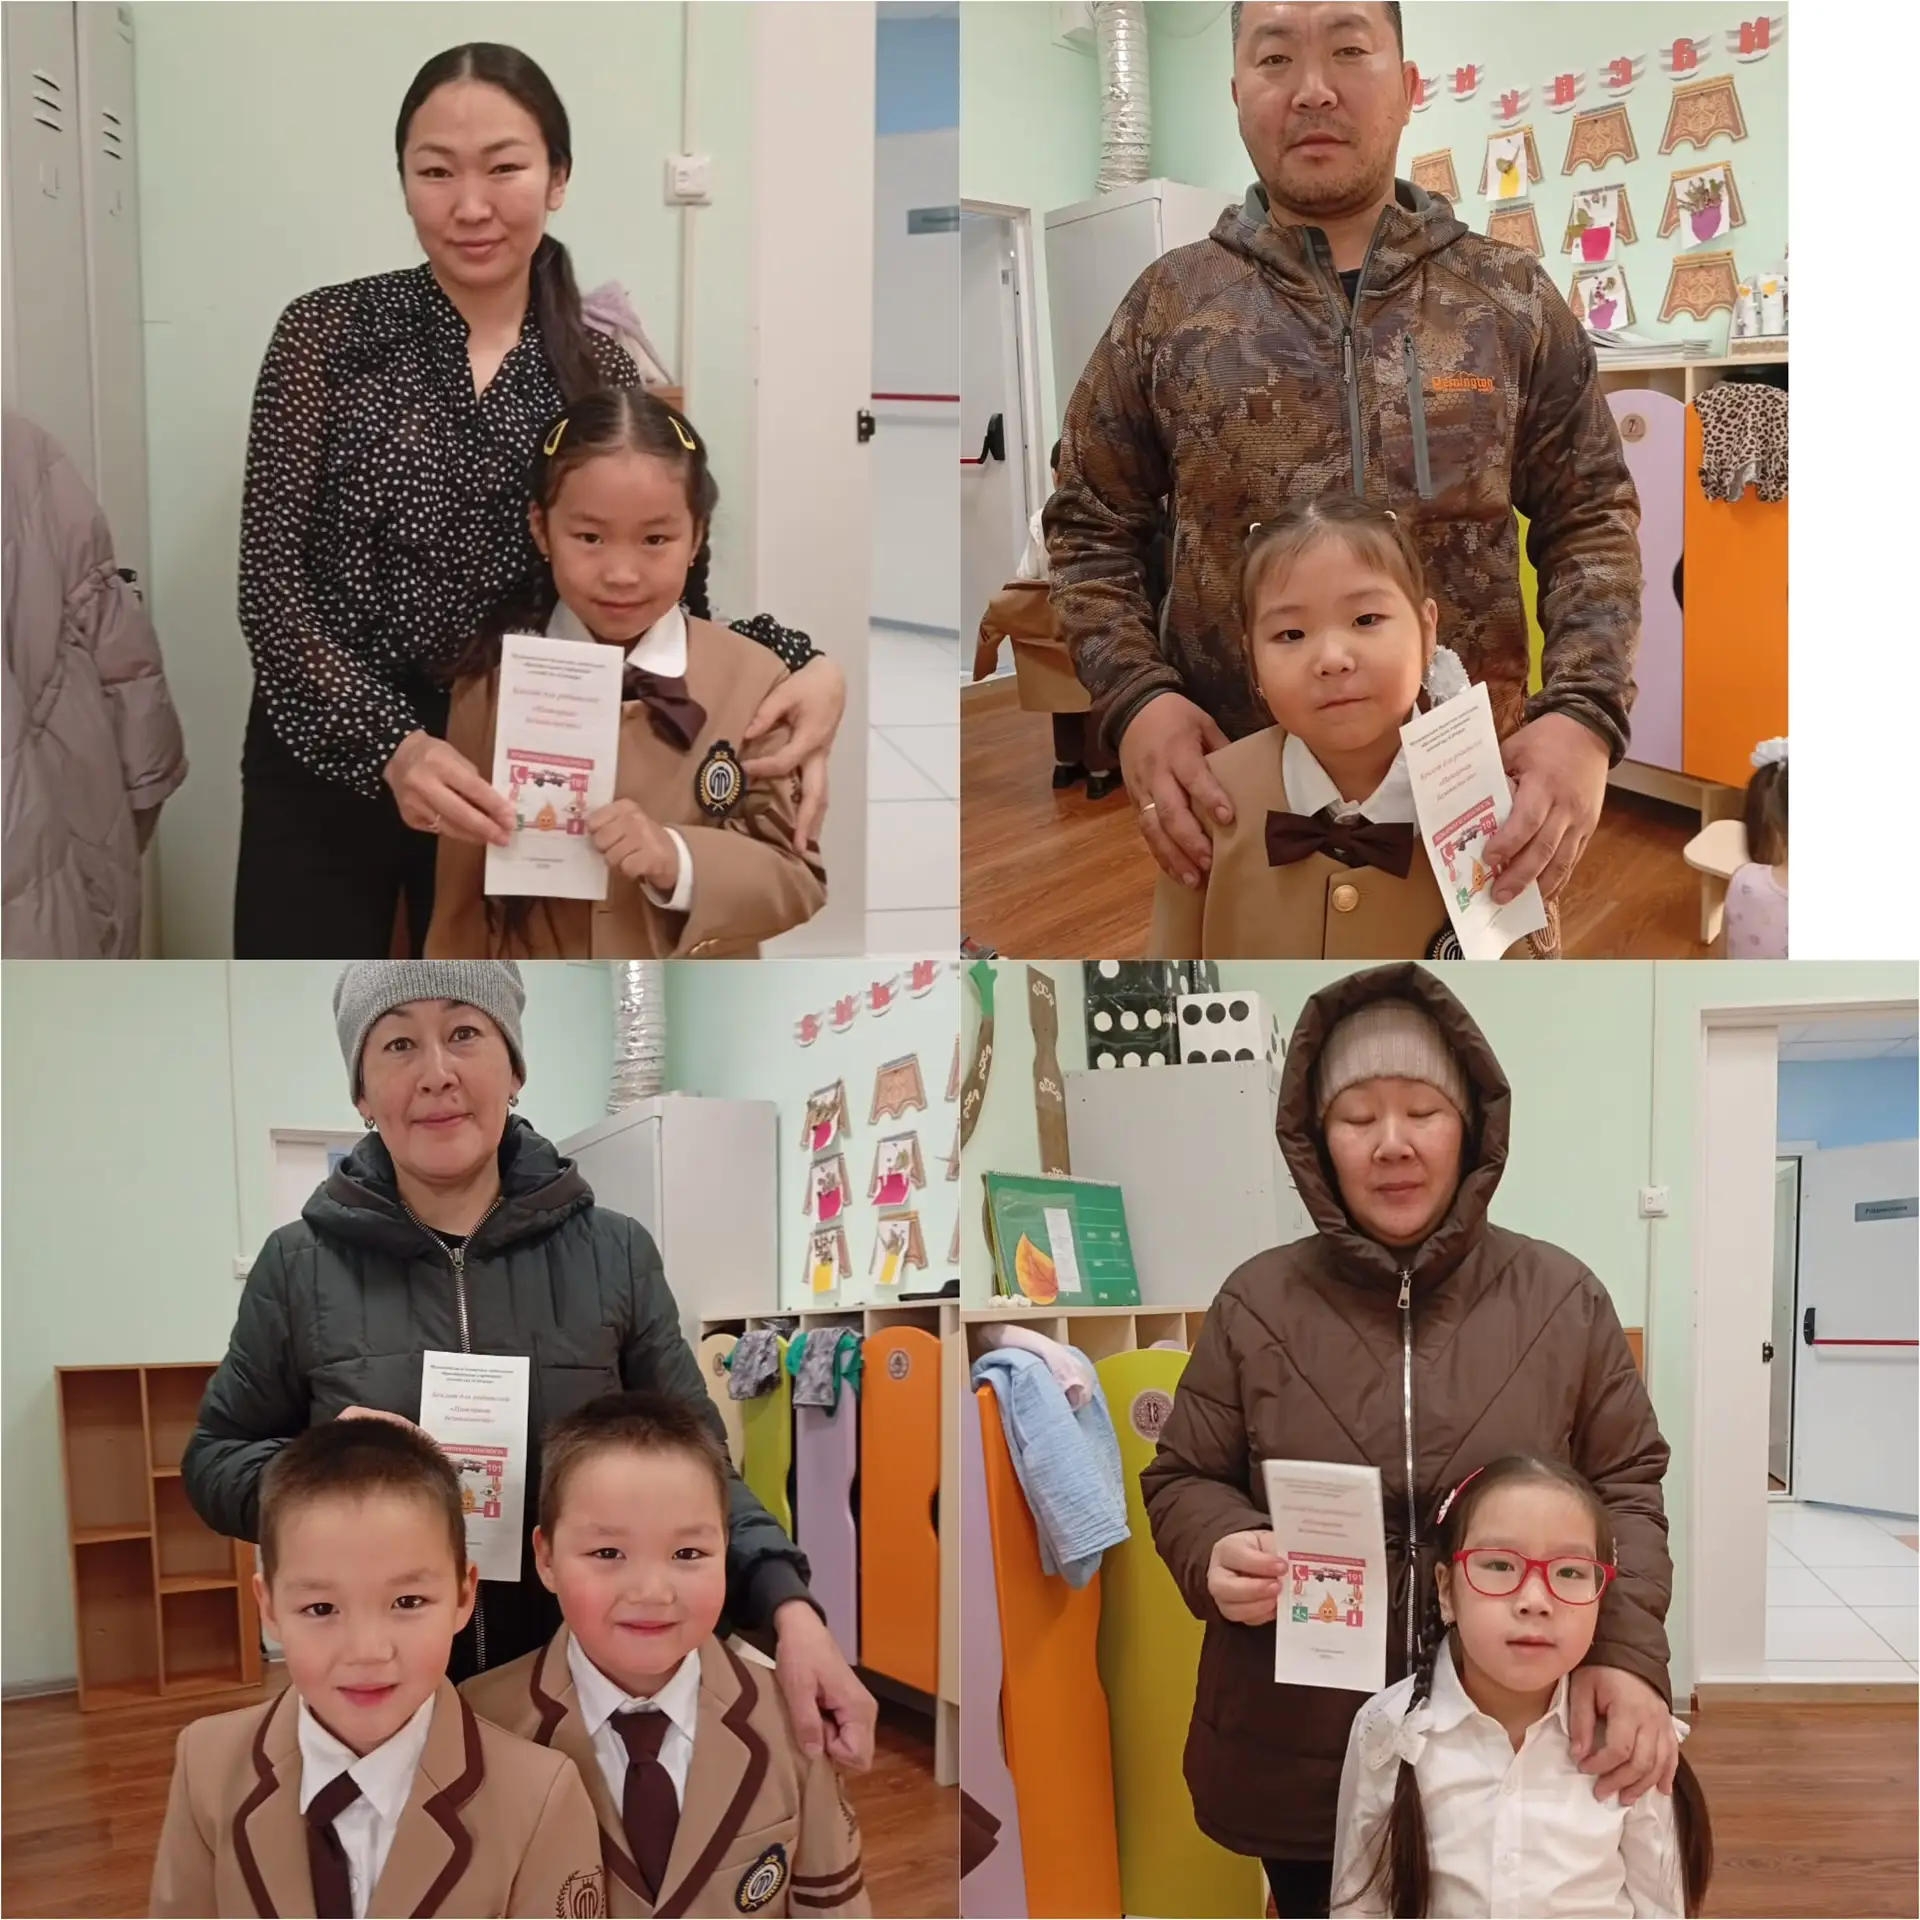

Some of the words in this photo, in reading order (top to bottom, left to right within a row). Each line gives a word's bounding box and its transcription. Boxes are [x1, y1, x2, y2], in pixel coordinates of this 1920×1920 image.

[1481, 815, 1496, 831] 101
[1147, 1401, 1160, 1424] 18
[487, 1463, 502, 1473] 101
